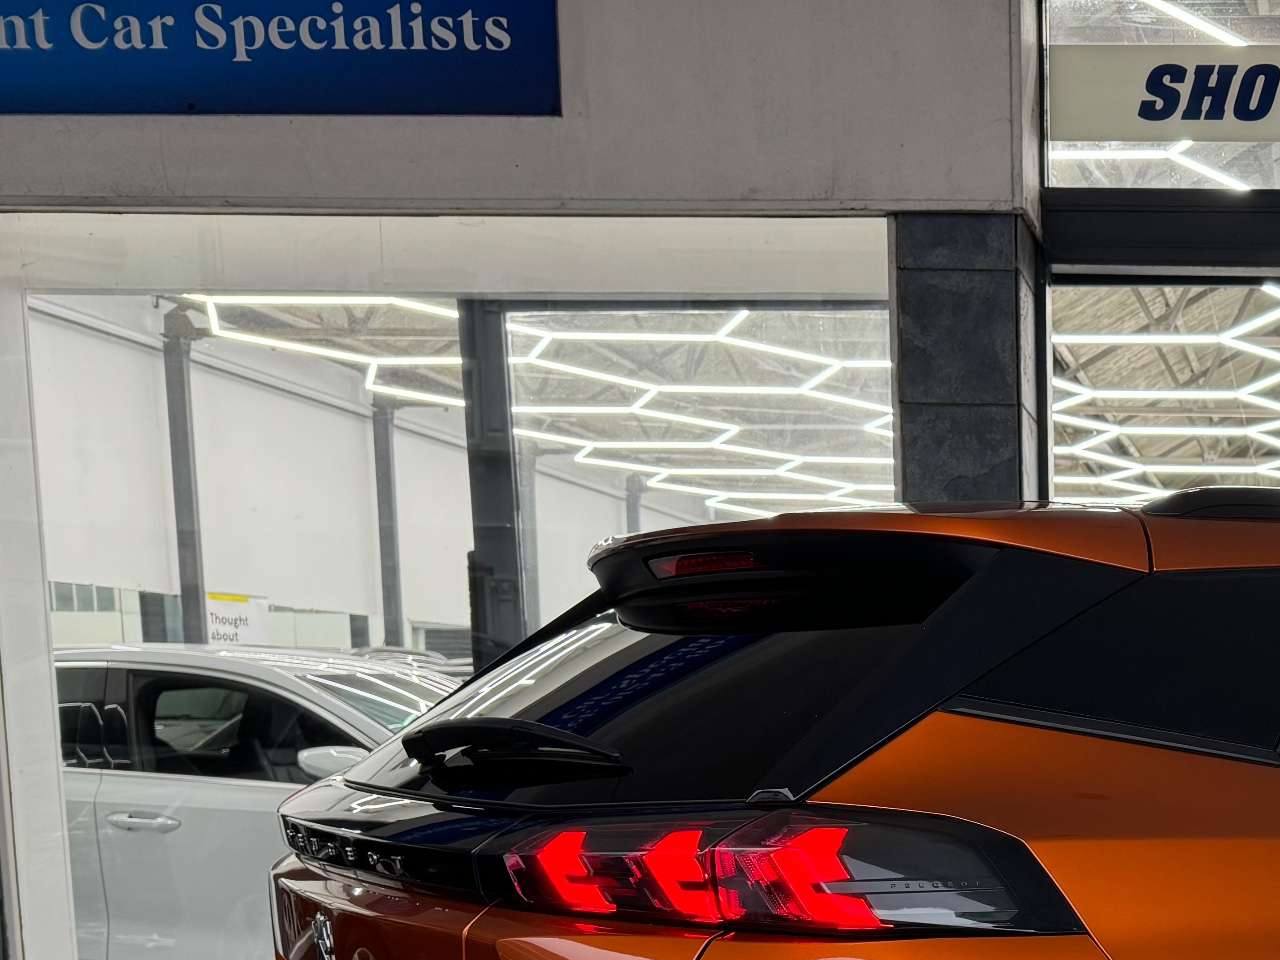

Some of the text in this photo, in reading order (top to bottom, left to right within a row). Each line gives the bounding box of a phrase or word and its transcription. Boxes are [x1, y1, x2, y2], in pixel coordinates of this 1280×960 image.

[70, 3, 175, 50] Car
[194, 2, 512, 62] Specialists
[209, 612, 249, 628] Thought
[210, 629, 239, 642] about
